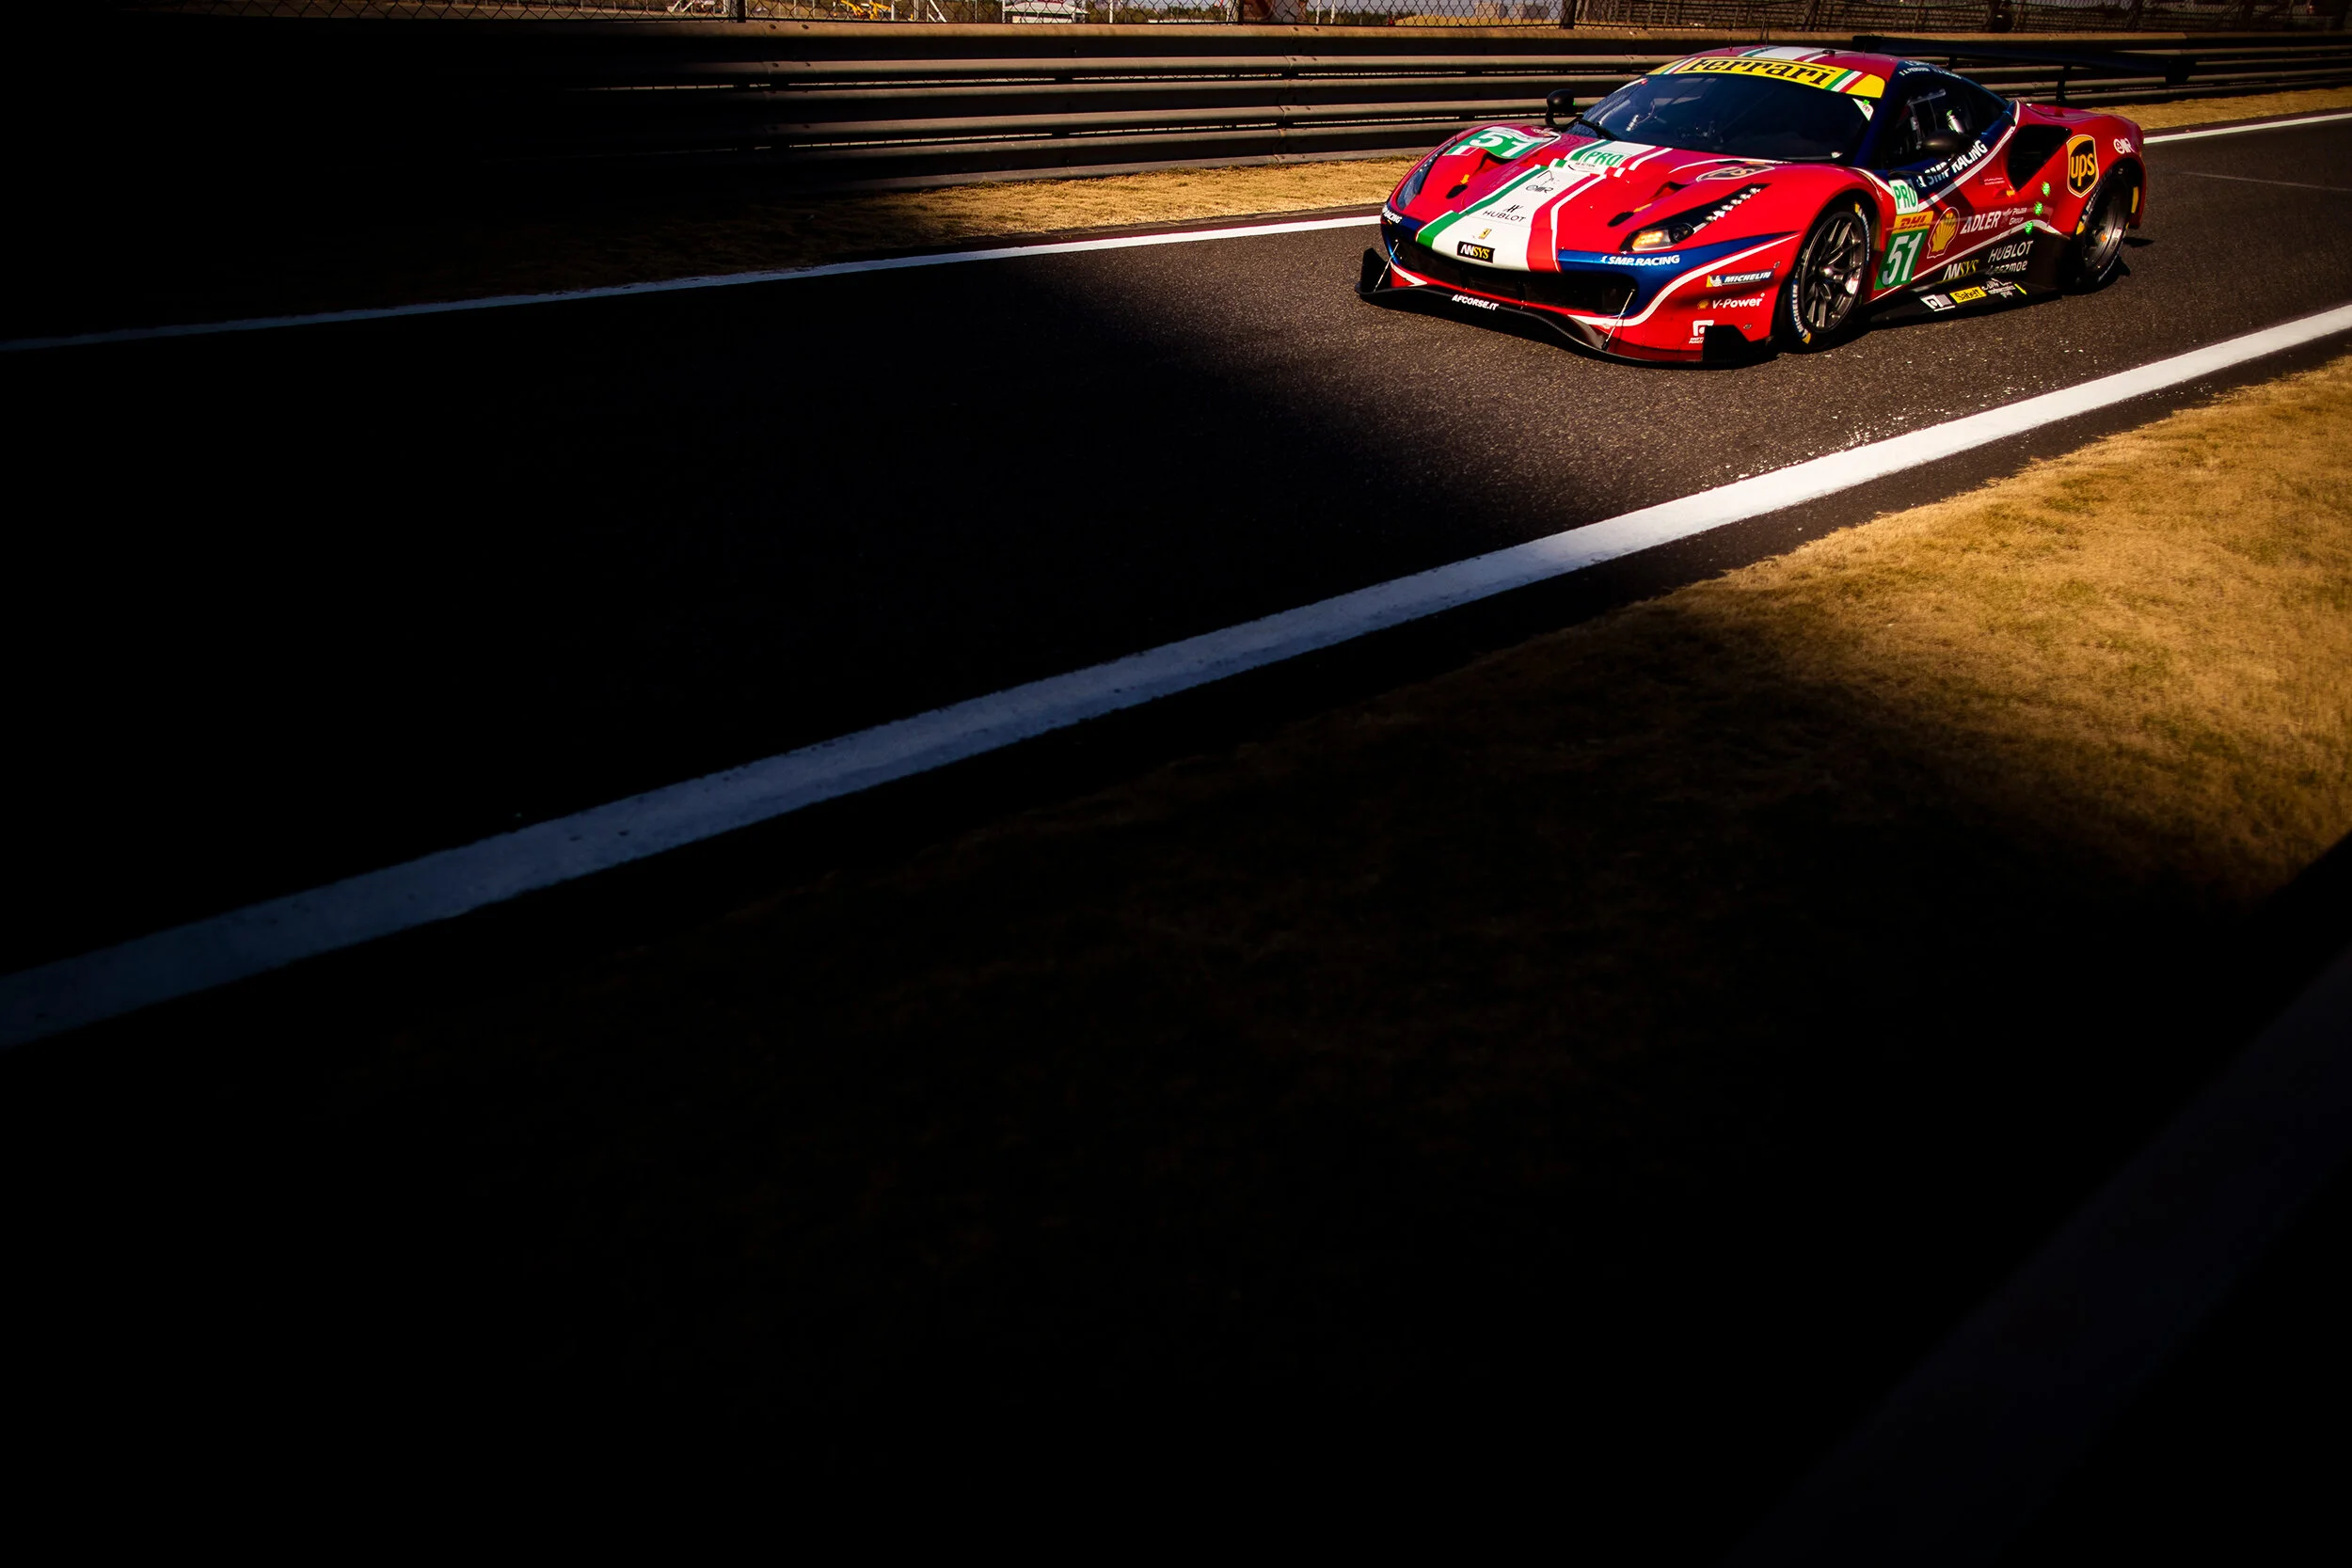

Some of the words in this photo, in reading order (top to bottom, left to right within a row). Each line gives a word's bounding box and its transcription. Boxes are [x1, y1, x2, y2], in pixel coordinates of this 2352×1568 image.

[1683, 56, 1837, 85] Ferrari
[1470, 131, 1534, 157] 51
[1583, 150, 1624, 166] PRO
[2071, 152, 2096, 187] ups
[1893, 184, 1917, 210] PRO
[1483, 210, 1527, 223] HUBLOT
[1960, 211, 2002, 235] ADLER
[1460, 244, 1490, 260] ANSYS
[1608, 256, 1634, 266] SMP
[1634, 254, 1680, 266] RACING
[1882, 231, 1924, 285] 51
[1987, 240, 2034, 263] HUBLOT
[1724, 271, 1772, 283] MICHELIN
[1943, 259, 1979, 281] ANSYS
[1452, 293, 1500, 311] AFCORSE.IT
[1711, 296, 1763, 309] V-Power
